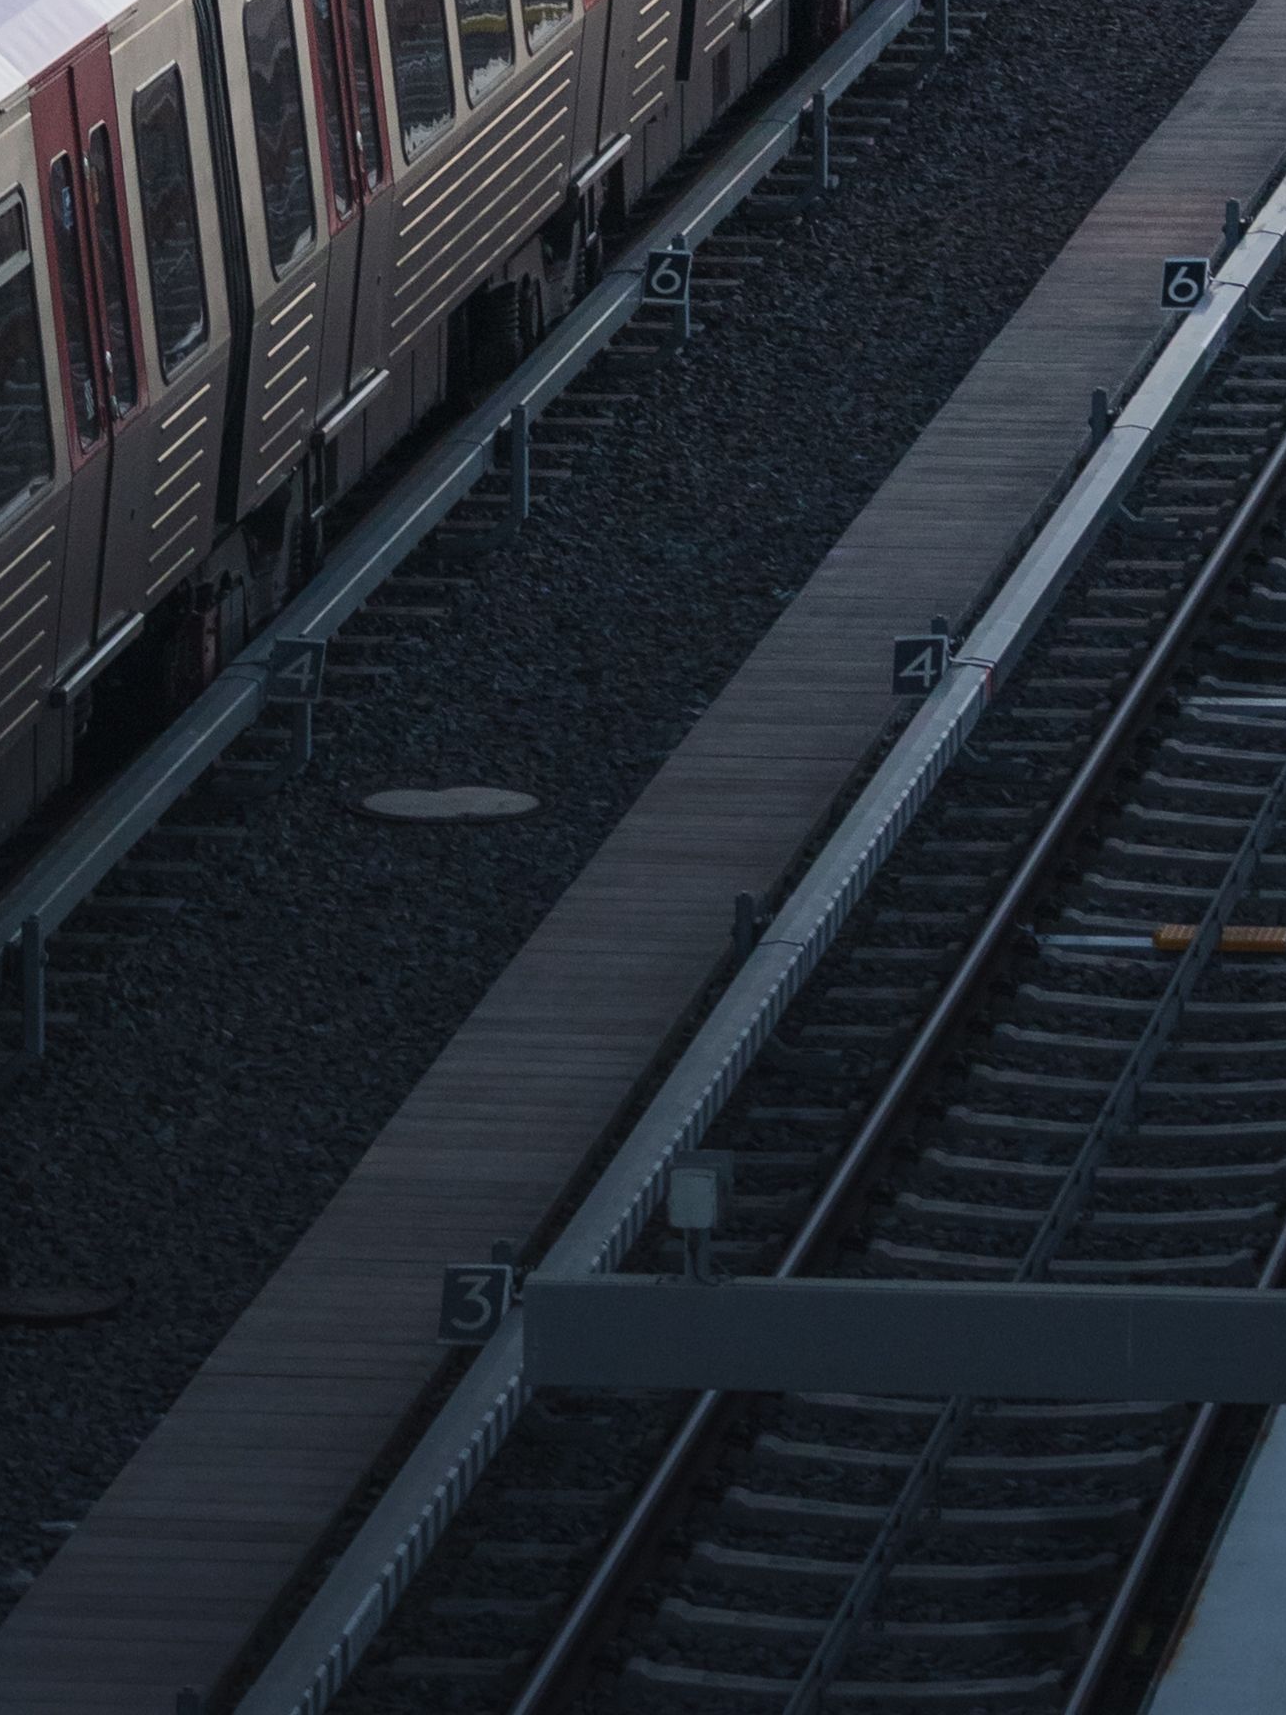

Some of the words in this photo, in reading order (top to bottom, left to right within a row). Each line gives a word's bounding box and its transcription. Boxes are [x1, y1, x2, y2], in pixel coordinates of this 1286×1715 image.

[650, 257, 682, 295] 6
[1167, 265, 1199, 303] 6
[276, 649, 314, 692] 4
[899, 646, 938, 688] 4
[449, 1274, 493, 1331] 3
